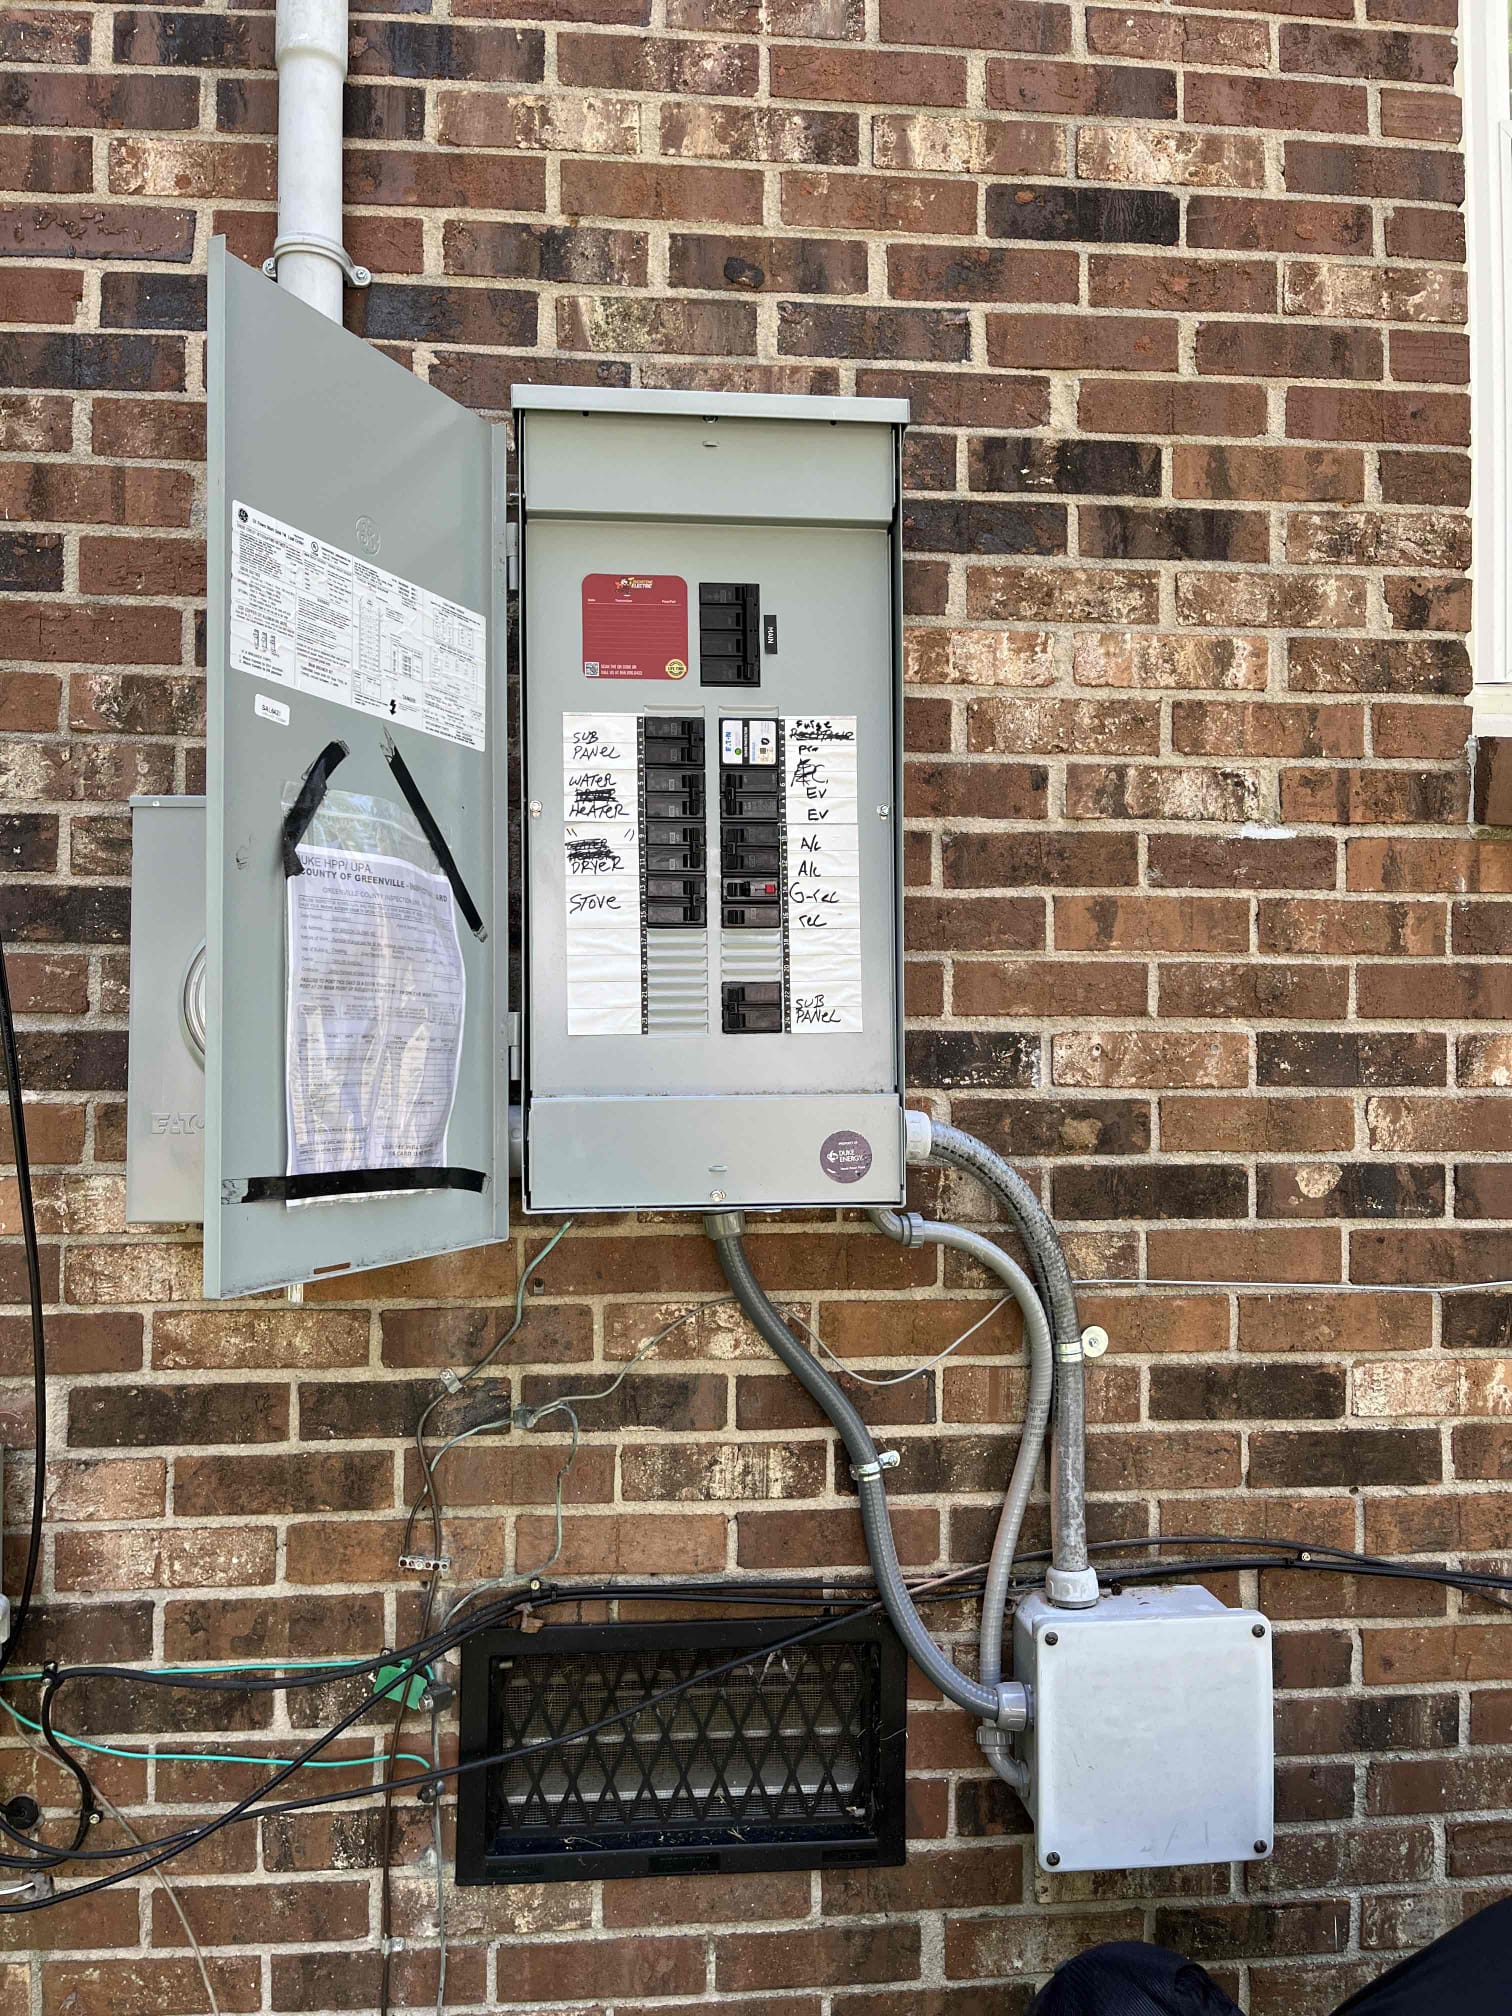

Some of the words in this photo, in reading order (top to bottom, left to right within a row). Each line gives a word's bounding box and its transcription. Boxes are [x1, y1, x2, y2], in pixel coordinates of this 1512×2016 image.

[573, 731, 599, 744] SUB
[340, 873, 352, 881] OF
[354, 874, 405, 888] GREENVILLE
[322, 887, 360, 896] GREENVILLE
[796, 995, 825, 1008] SUB
[151, 1112, 205, 1135] EATO
[839, 1155, 863, 1163] ENERGY
